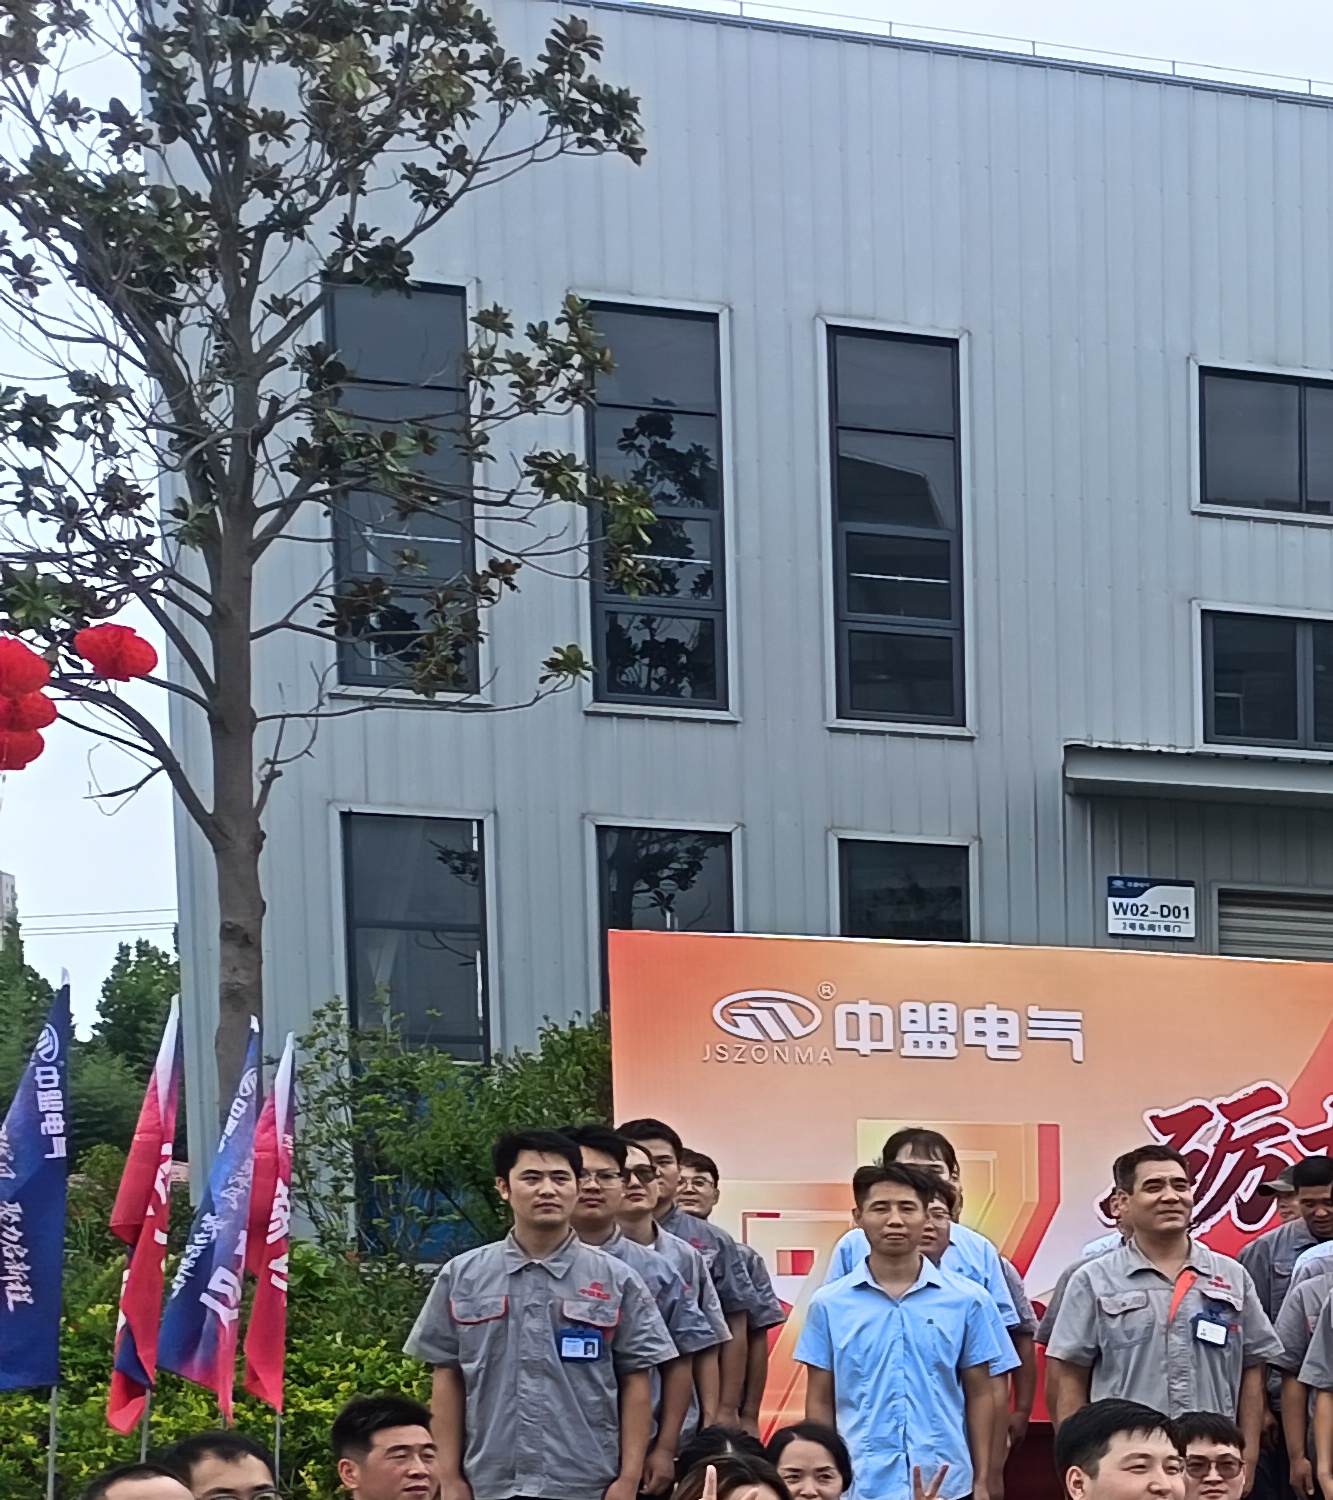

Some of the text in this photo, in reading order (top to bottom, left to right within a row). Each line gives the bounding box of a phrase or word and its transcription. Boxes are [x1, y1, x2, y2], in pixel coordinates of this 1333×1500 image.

[1112, 901, 1190, 920] W02-D01
[834, 999, 1085, 1064] 中盟电气
[702, 1043, 834, 1066] JSZONMA
